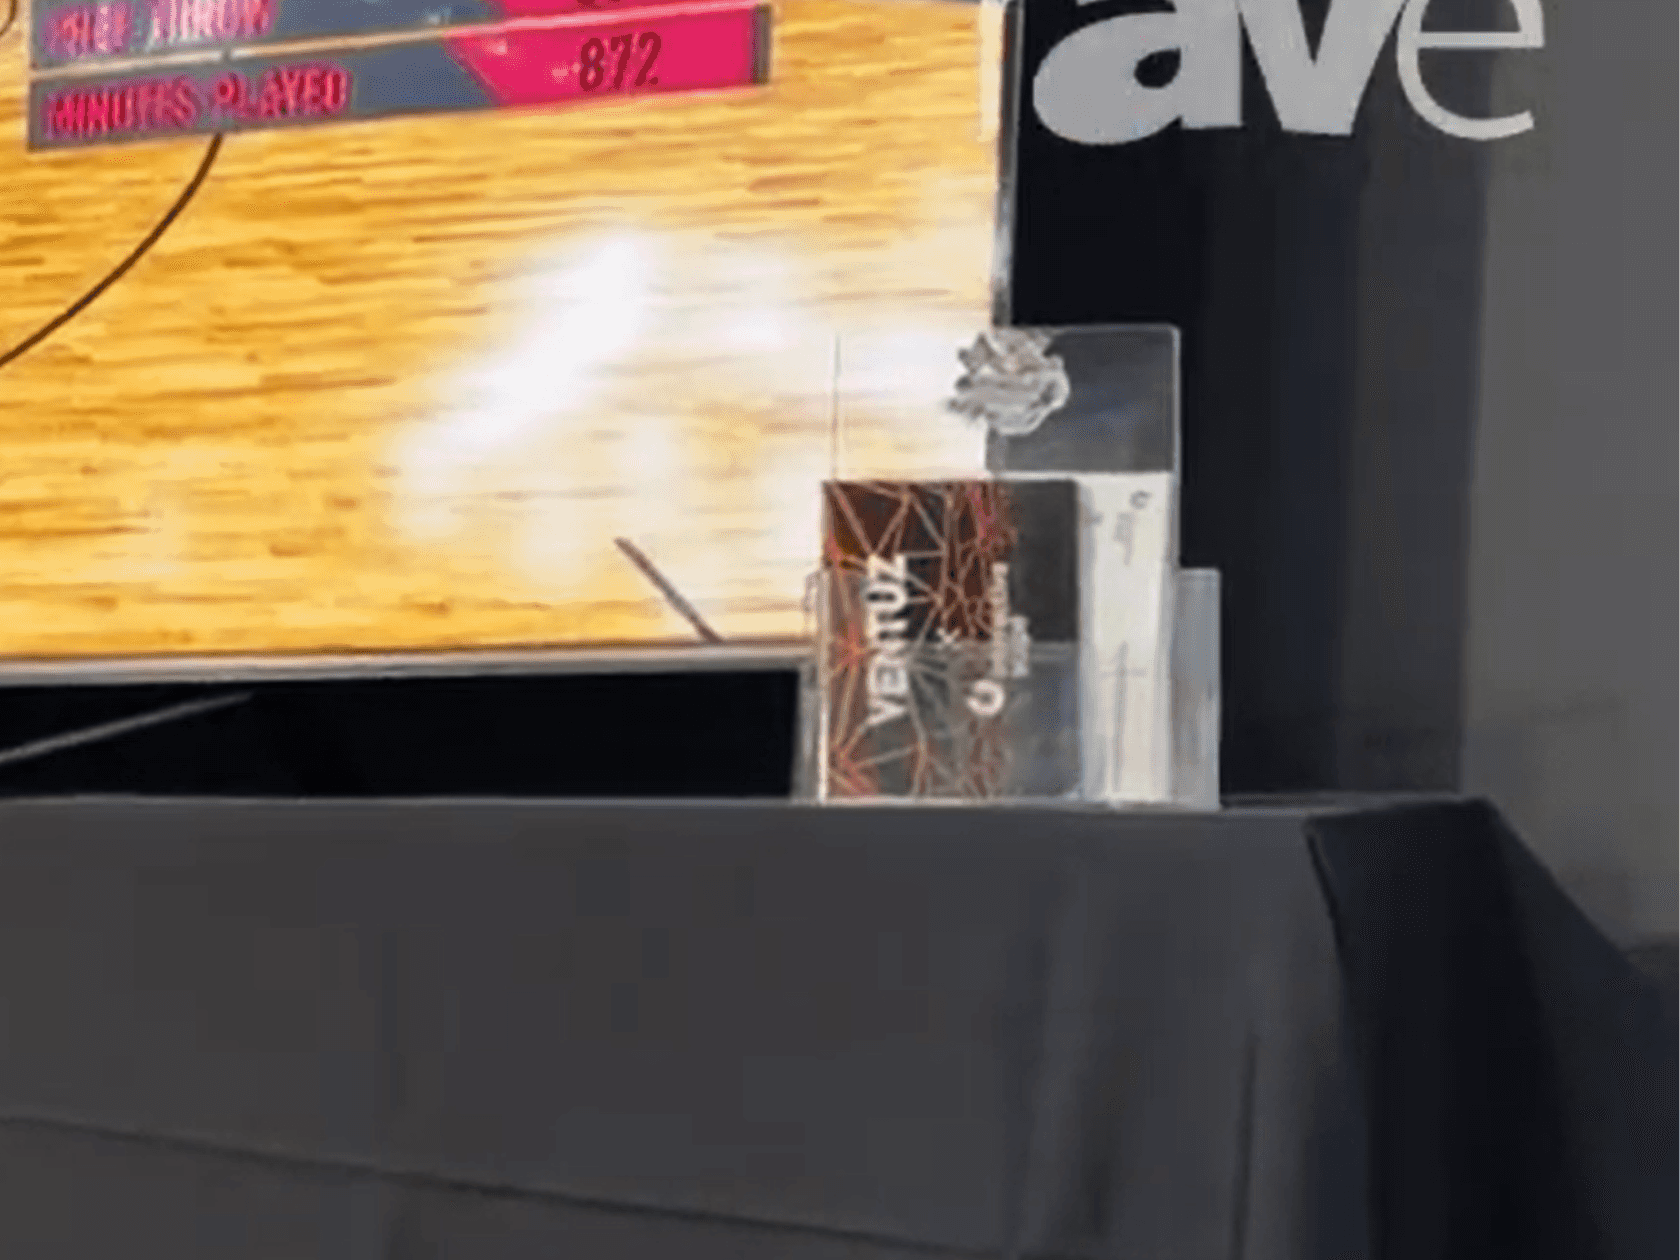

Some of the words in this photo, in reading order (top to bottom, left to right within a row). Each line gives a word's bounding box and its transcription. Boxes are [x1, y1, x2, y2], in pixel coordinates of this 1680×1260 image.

[44, 74, 198, 138] MINUTES
[207, 60, 350, 124] PLAYED
[579, 31, 661, 92] 872
[863, 553, 910, 726] VENTUZ
